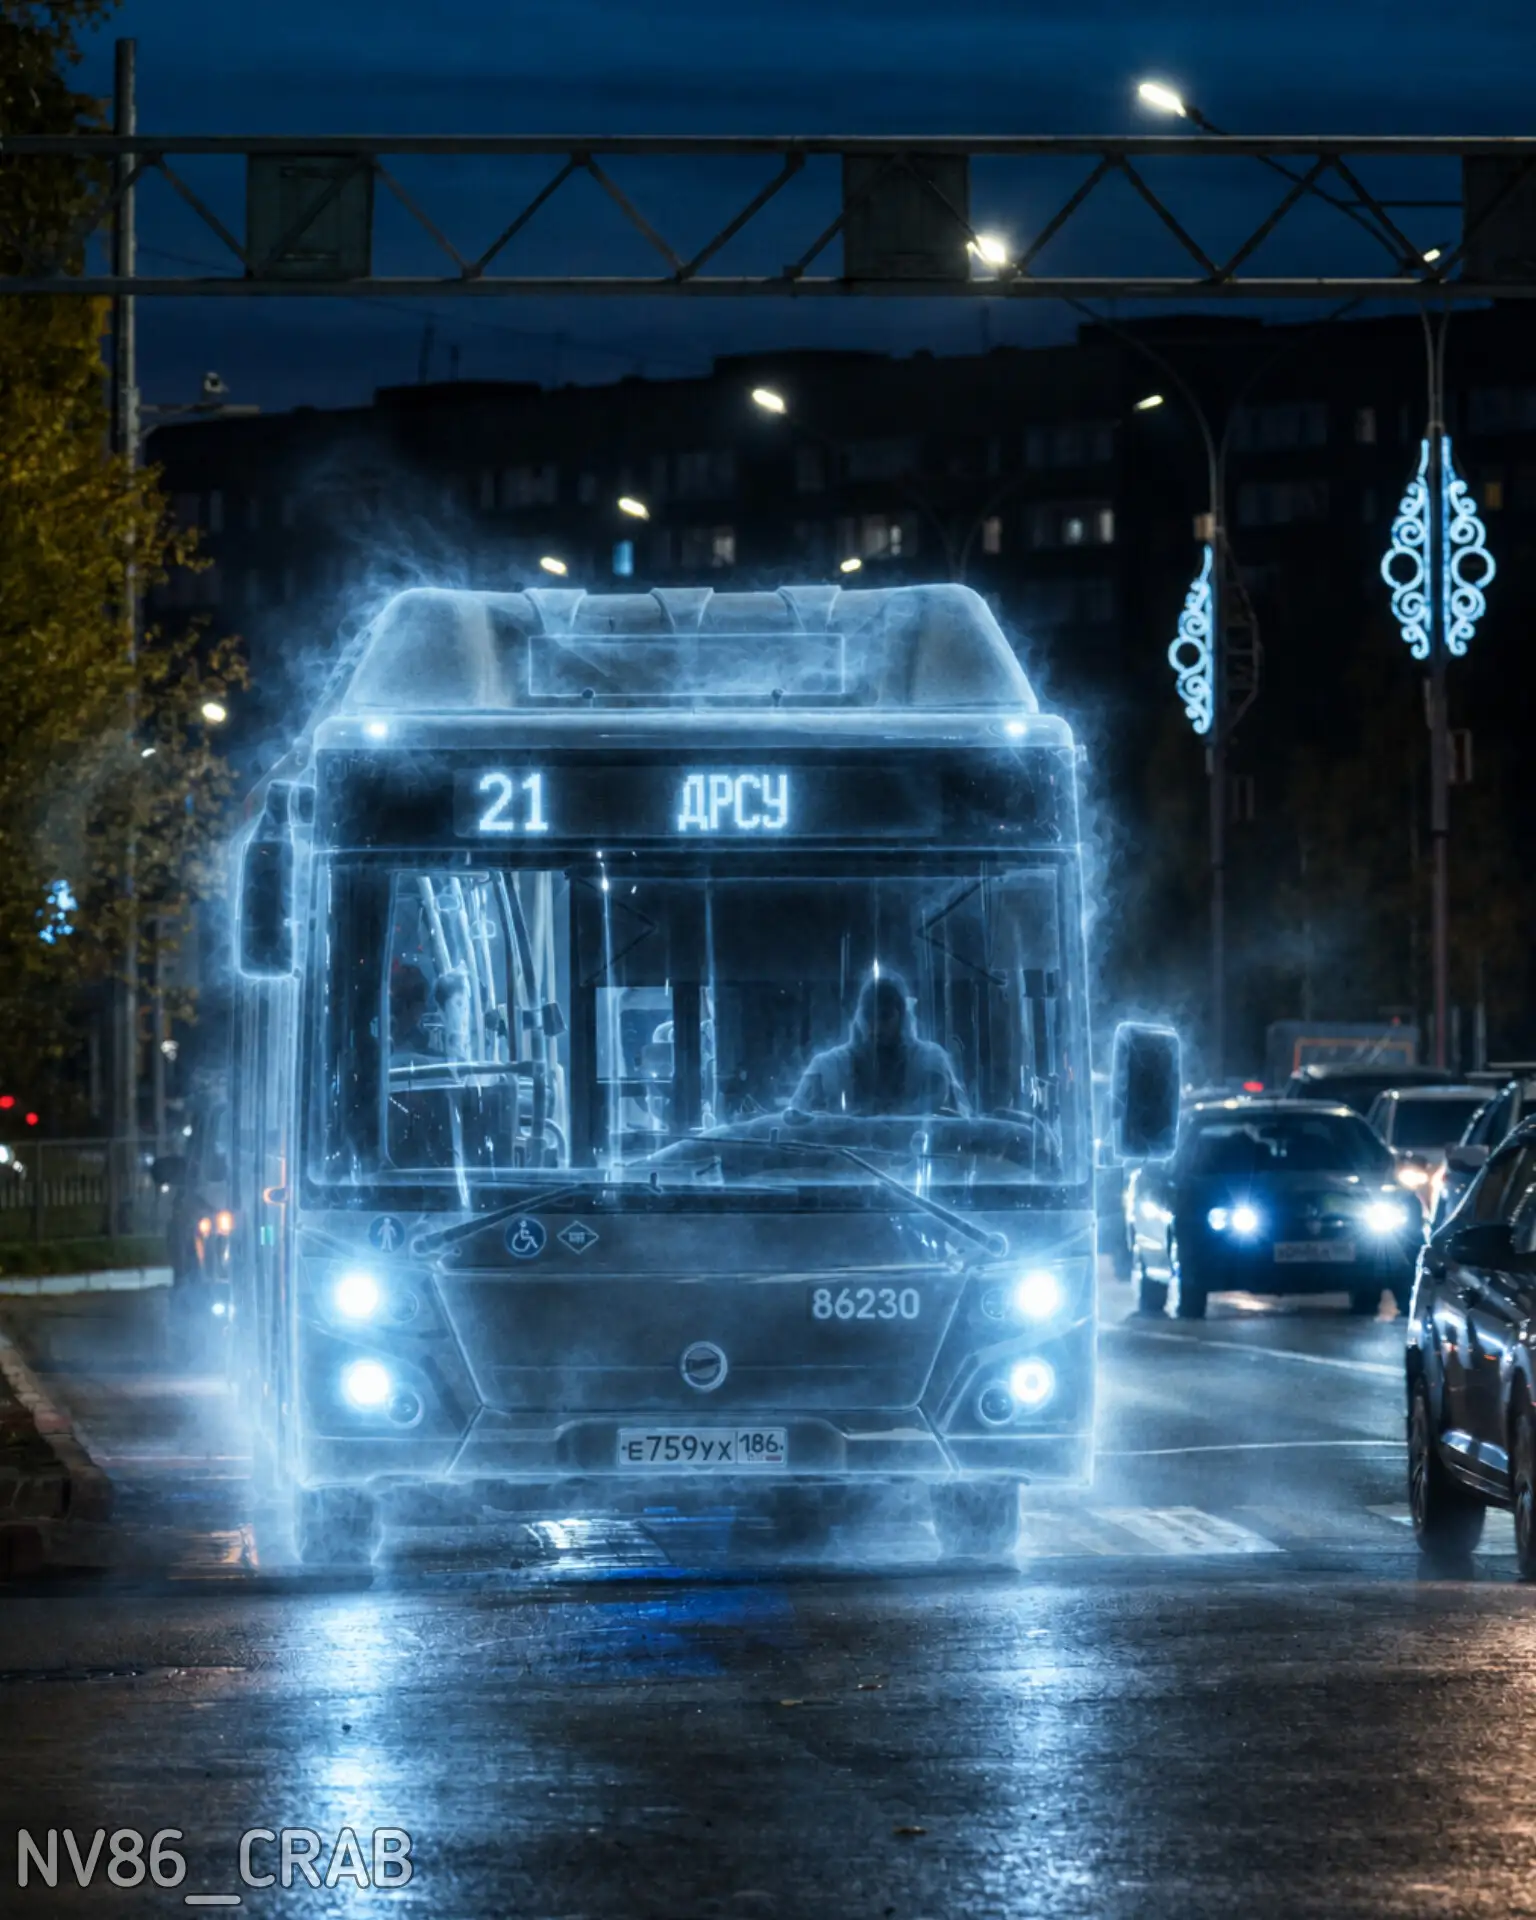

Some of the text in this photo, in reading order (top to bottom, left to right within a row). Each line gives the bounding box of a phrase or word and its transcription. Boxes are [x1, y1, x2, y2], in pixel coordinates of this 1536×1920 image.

[479, 772, 789, 831] 21 ДРСУ
[812, 1287, 920, 1319] 86230
